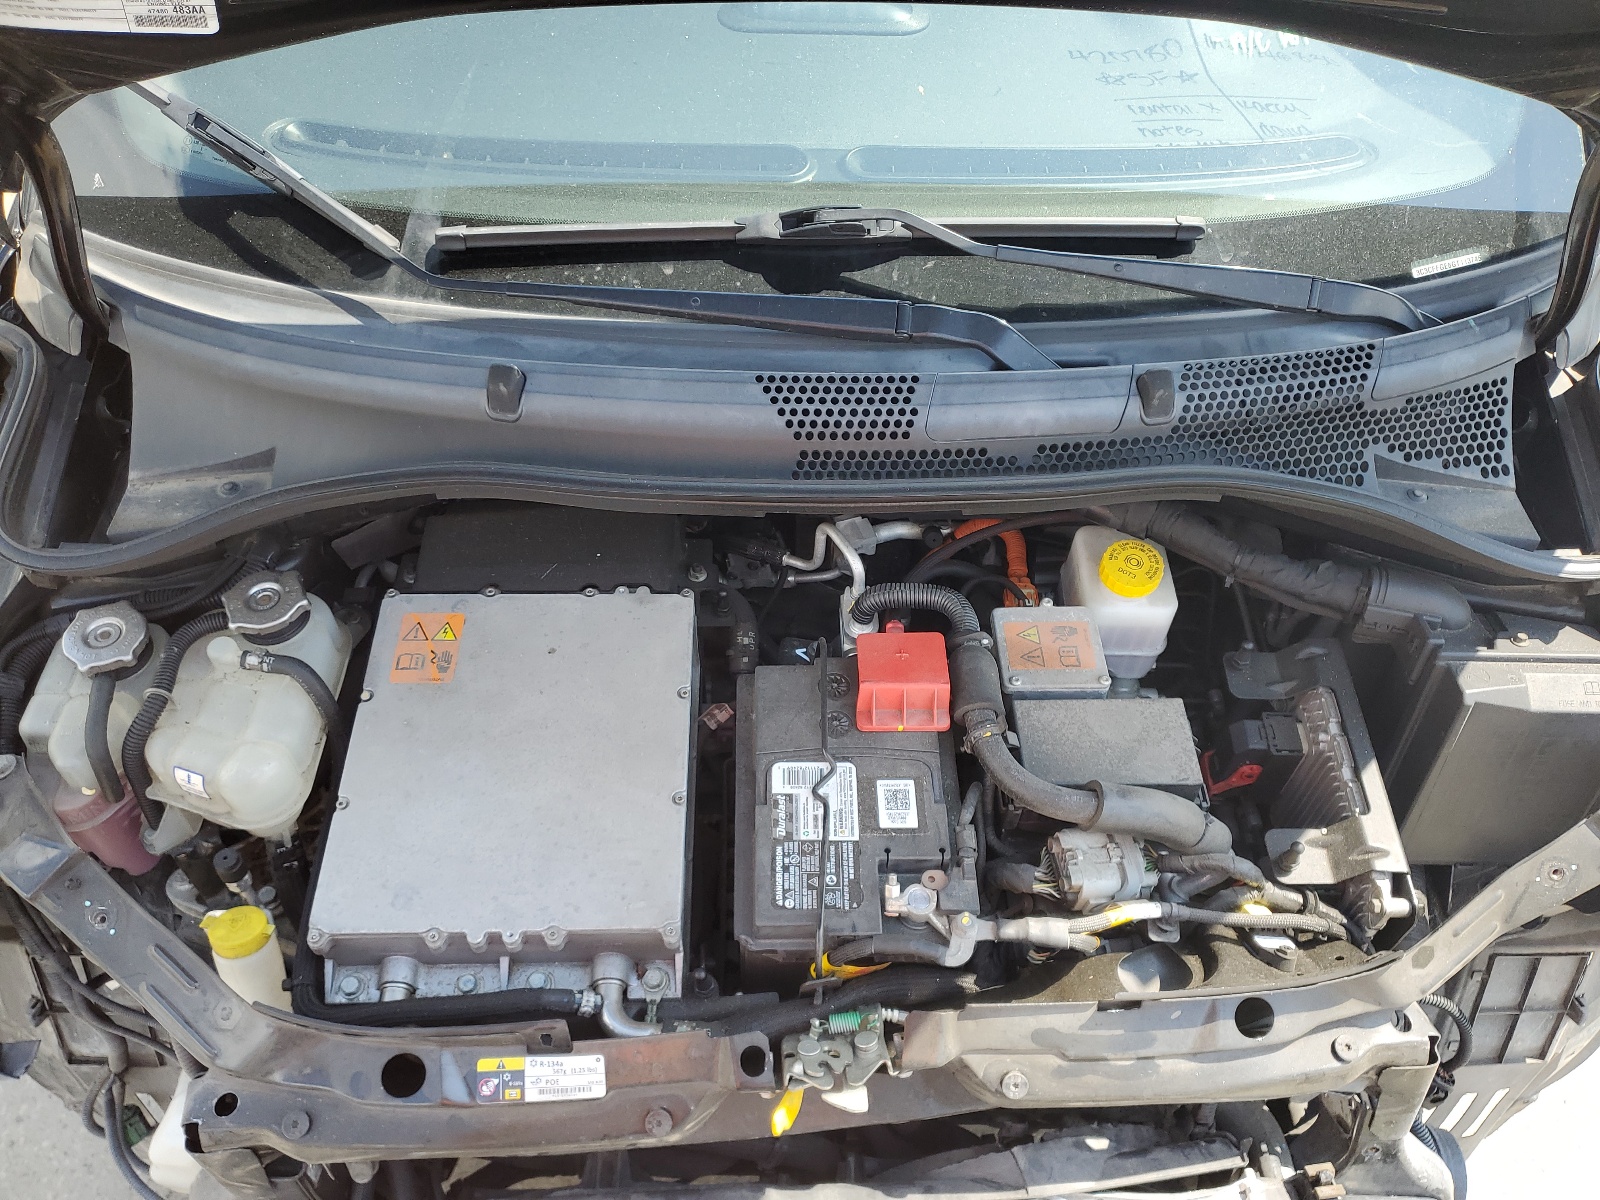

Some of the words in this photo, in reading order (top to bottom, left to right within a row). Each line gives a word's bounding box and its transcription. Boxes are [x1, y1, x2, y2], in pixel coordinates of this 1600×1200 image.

[172, 5, 207, 15] 483AA
[776, 794, 786, 838] Duralast
[776, 846, 784, 900] DANGER/POISON
[539, 1060, 564, 1068] R-134a
[545, 1078, 560, 1086] POE
